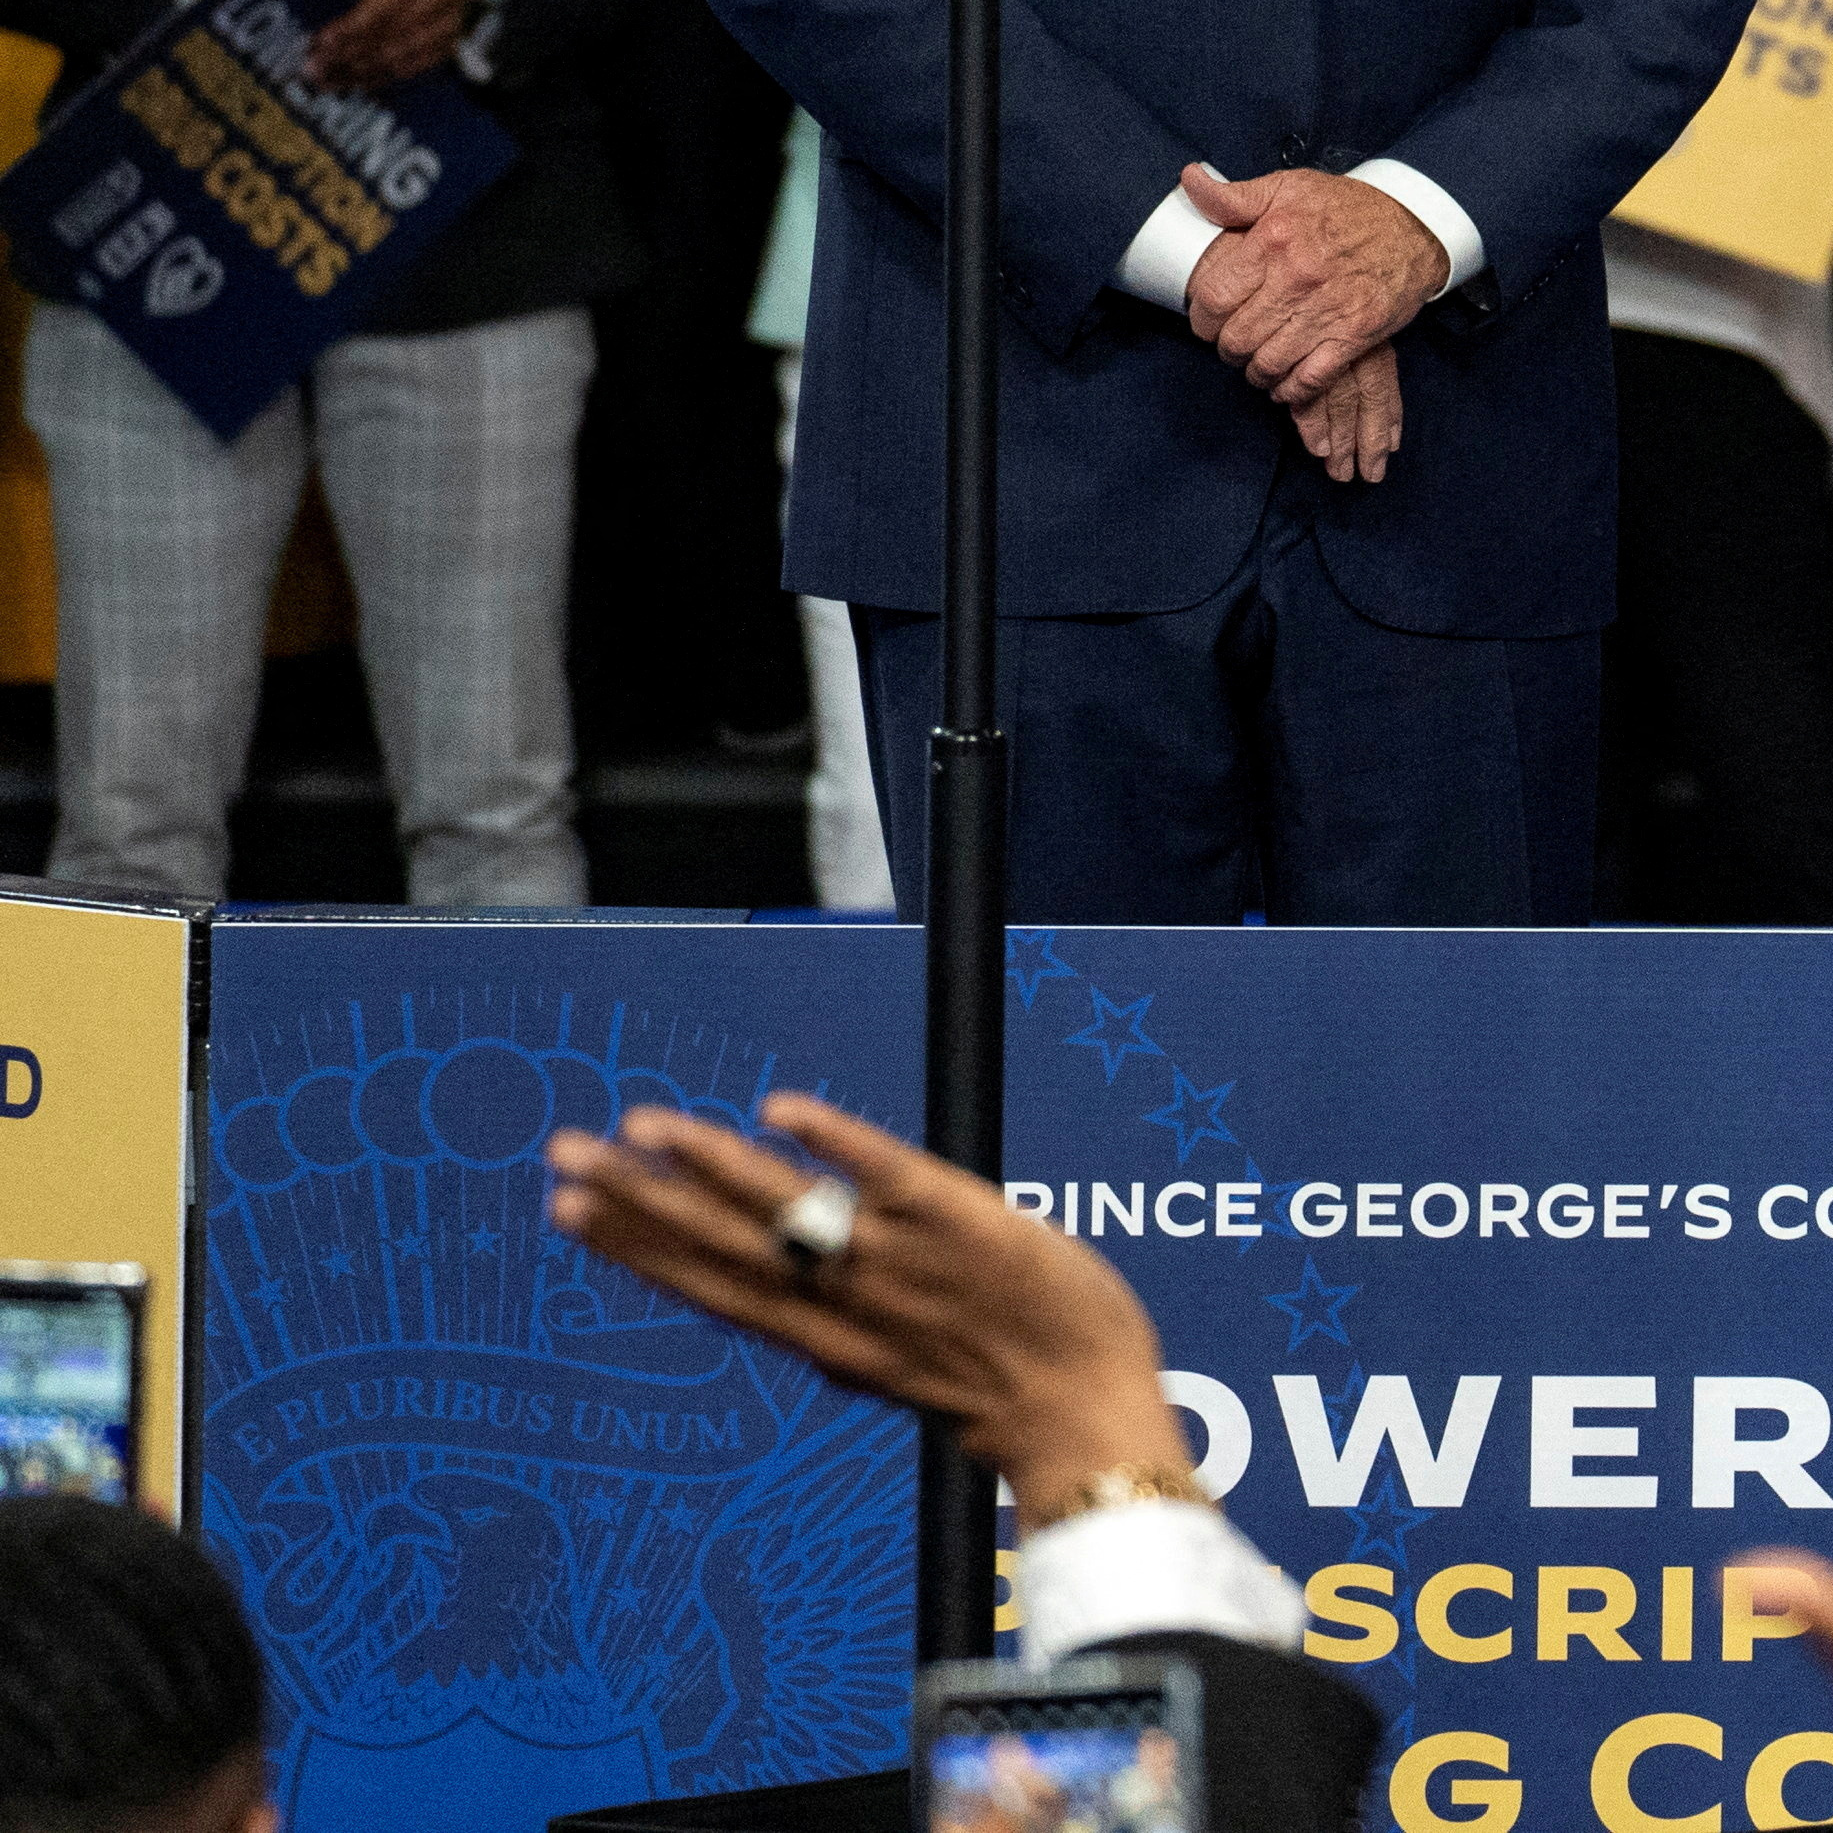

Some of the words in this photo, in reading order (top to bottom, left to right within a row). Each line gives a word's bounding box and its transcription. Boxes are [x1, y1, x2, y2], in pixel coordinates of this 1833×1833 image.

[1004, 1181, 1263, 1237] RINCE
[1289, 1182, 1732, 1239] GEORGE'S
[235, 1418, 279, 1465] E
[276, 1374, 555, 1449] PLURIBUS
[570, 1396, 744, 1455] UNUM
